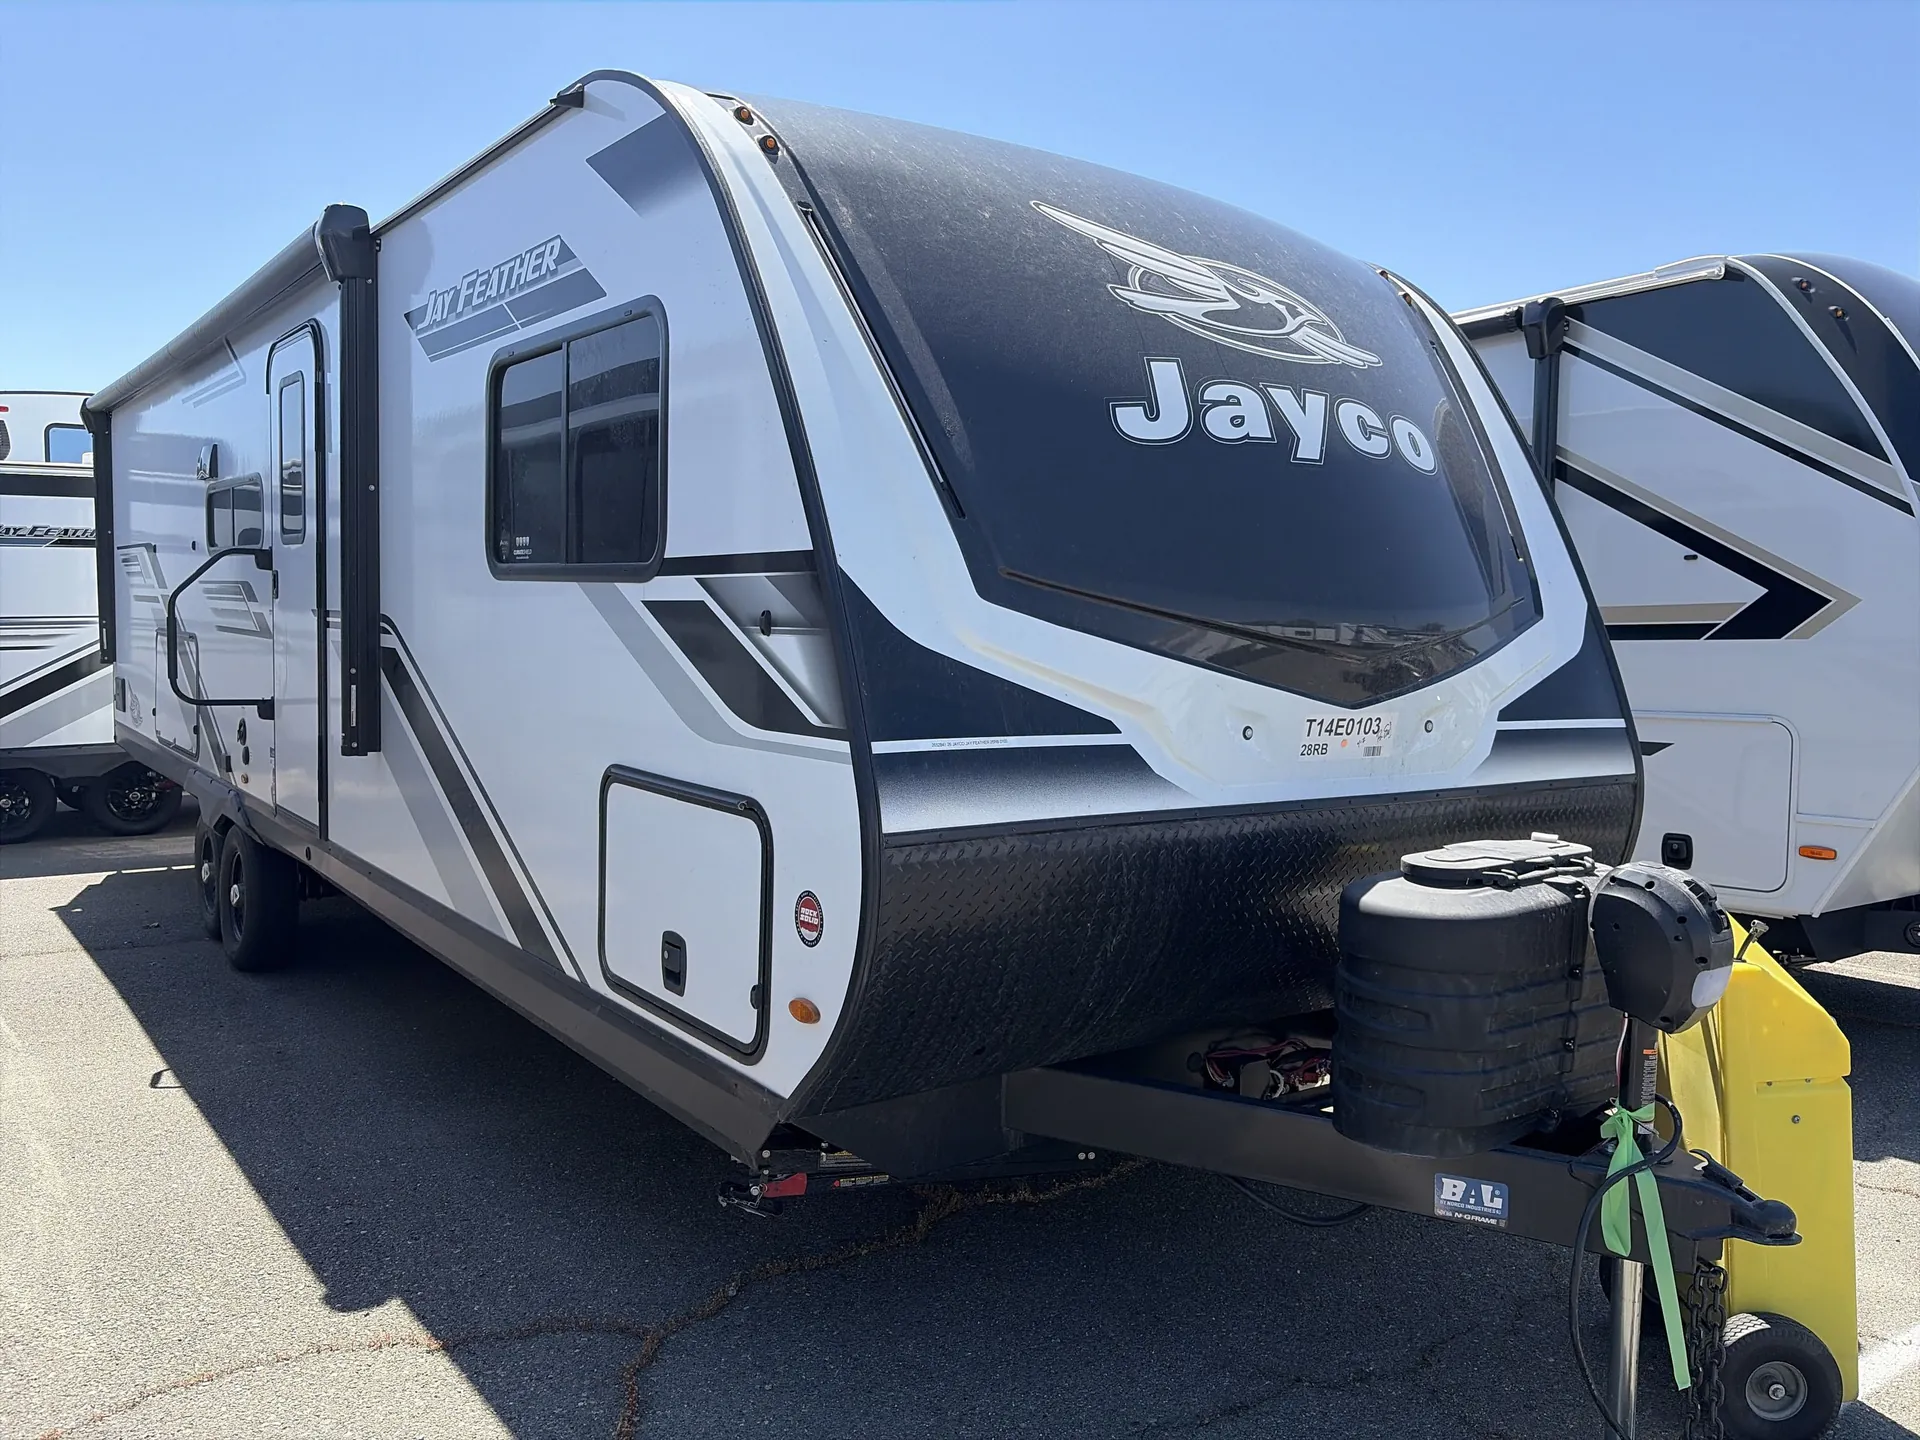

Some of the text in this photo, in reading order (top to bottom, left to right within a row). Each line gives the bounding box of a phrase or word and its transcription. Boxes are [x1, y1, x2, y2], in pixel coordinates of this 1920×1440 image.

[416, 238, 562, 330] JAY FEATHER
[1109, 357, 1438, 475] Jayco
[1305, 717, 1382, 737] T14E0103
[1300, 743, 1328, 756] 28RB
[801, 907, 818, 917] ROCK
[800, 914, 819, 925] SOLID
[1471, 1215, 1497, 1224] FRAME
